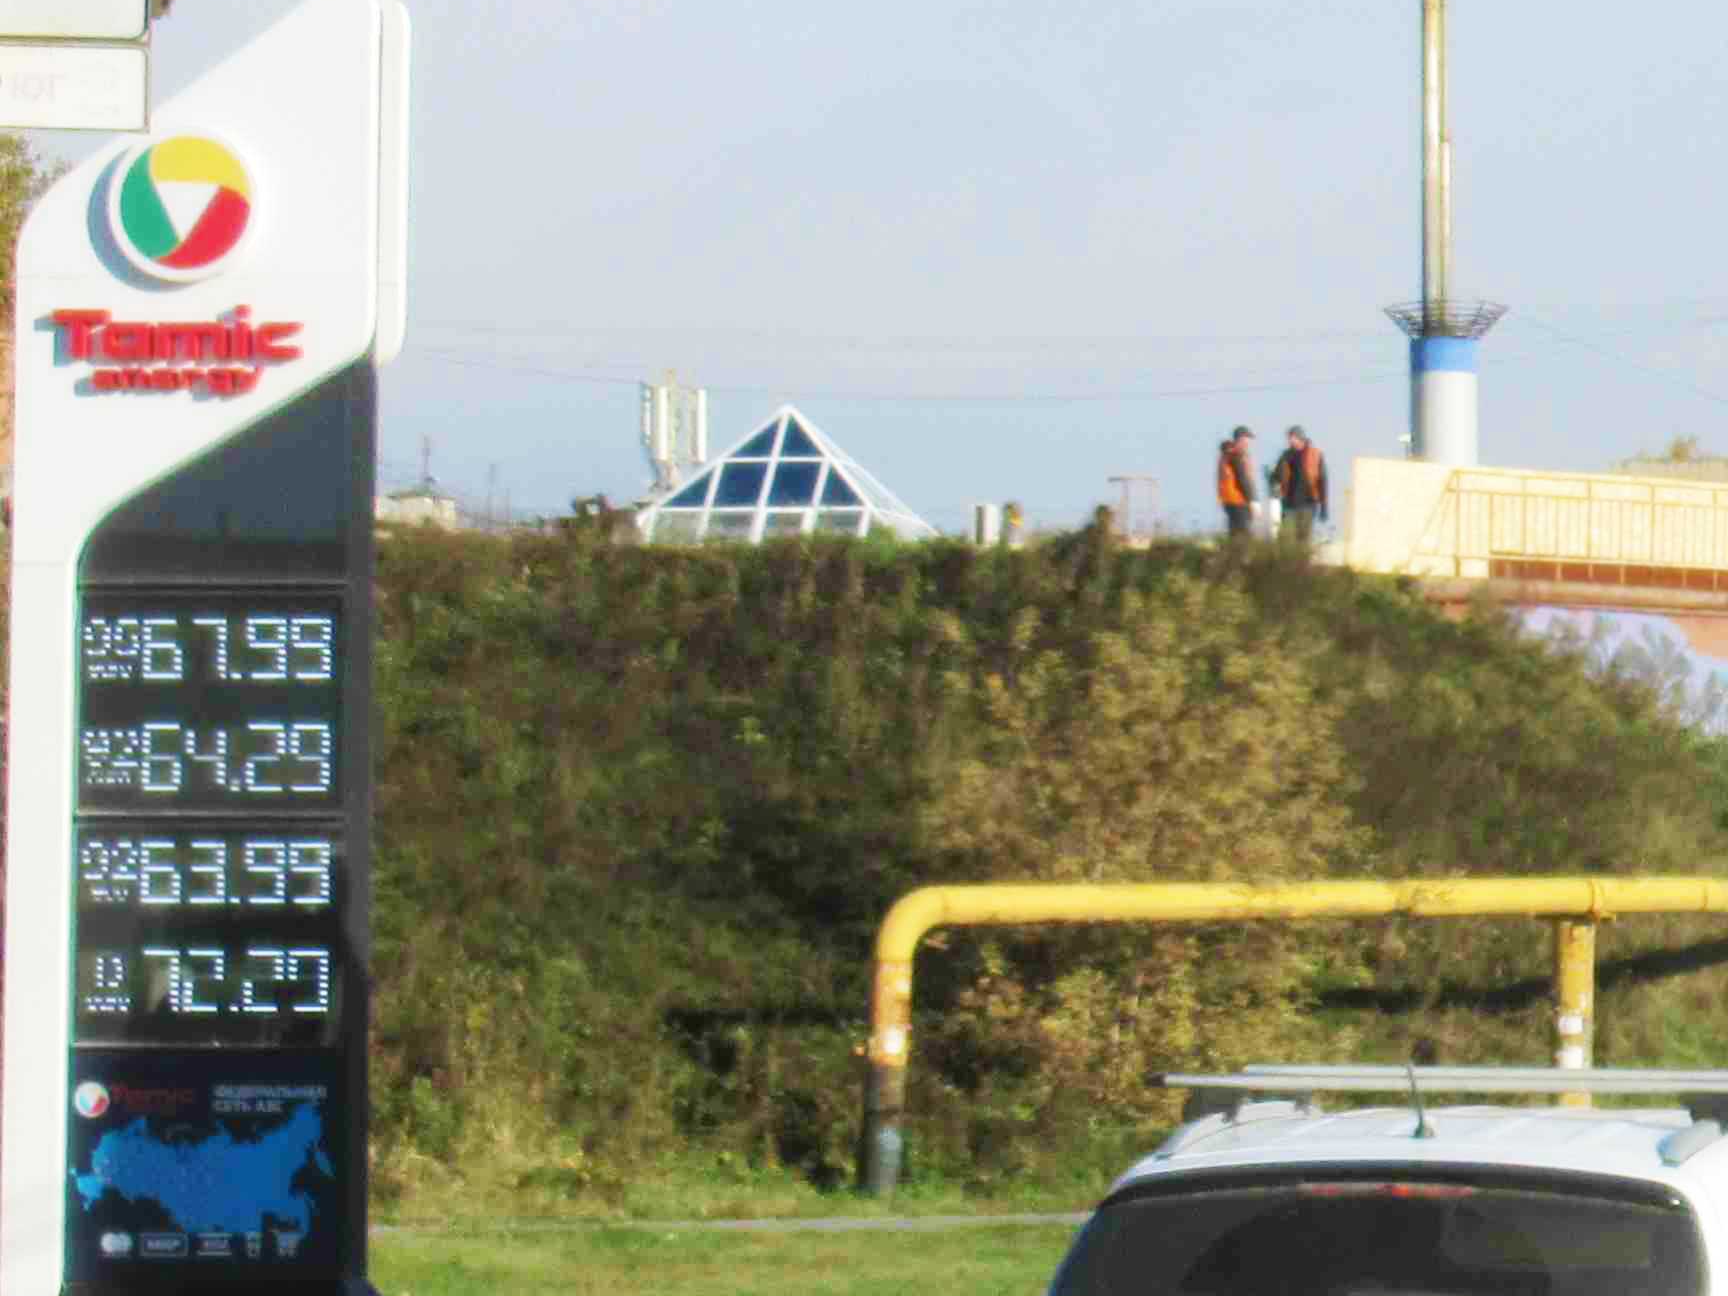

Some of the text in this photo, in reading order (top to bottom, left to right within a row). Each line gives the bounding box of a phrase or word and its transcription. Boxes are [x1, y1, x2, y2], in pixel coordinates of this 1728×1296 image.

[143, 618, 332, 679] 67.99
[141, 722, 331, 792] 64.29
[140, 842, 331, 903] 63.99
[143, 948, 329, 1012] 72.29
